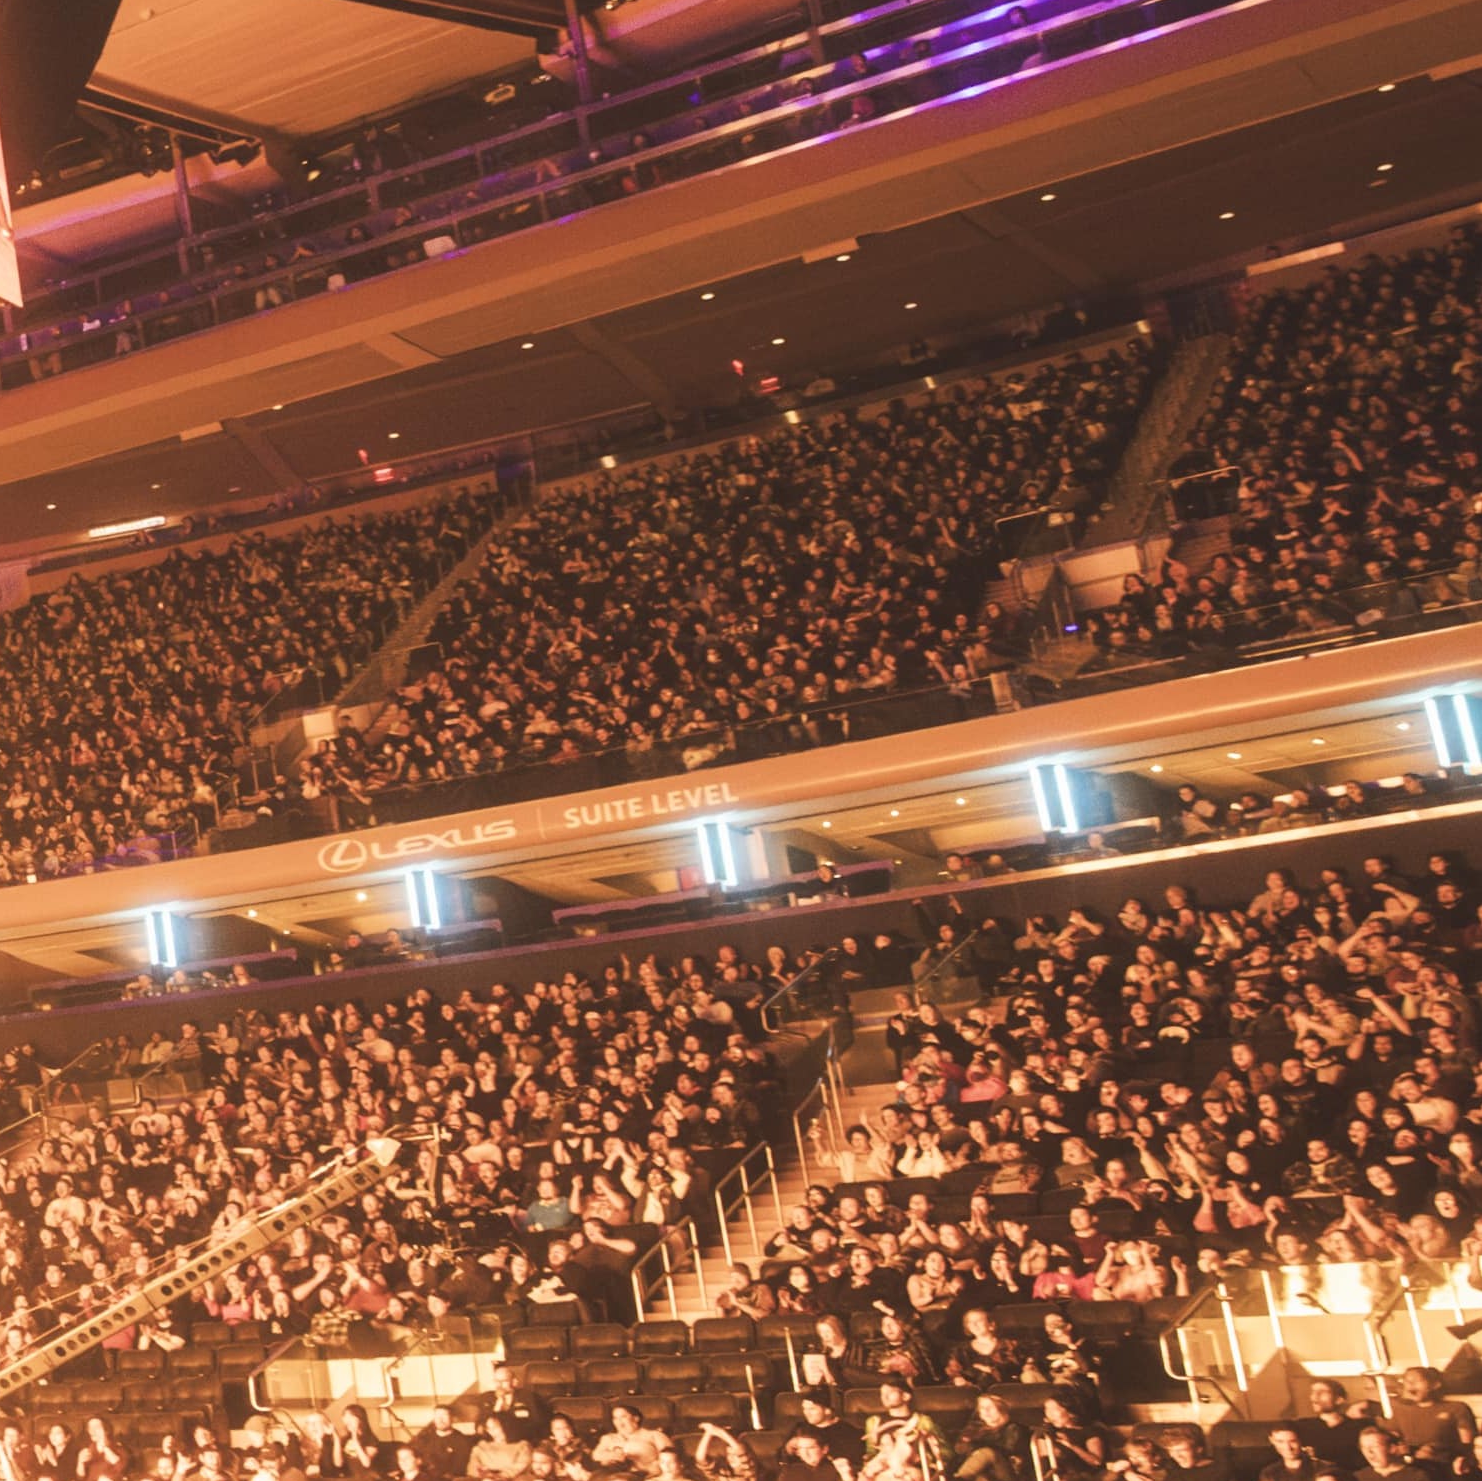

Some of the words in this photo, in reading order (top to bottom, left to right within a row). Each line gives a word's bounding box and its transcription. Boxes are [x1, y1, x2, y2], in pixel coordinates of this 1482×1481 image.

[370, 818, 517, 861] LEXUS
[564, 796, 645, 831] SUITE
[651, 781, 739, 816] LEVEL
